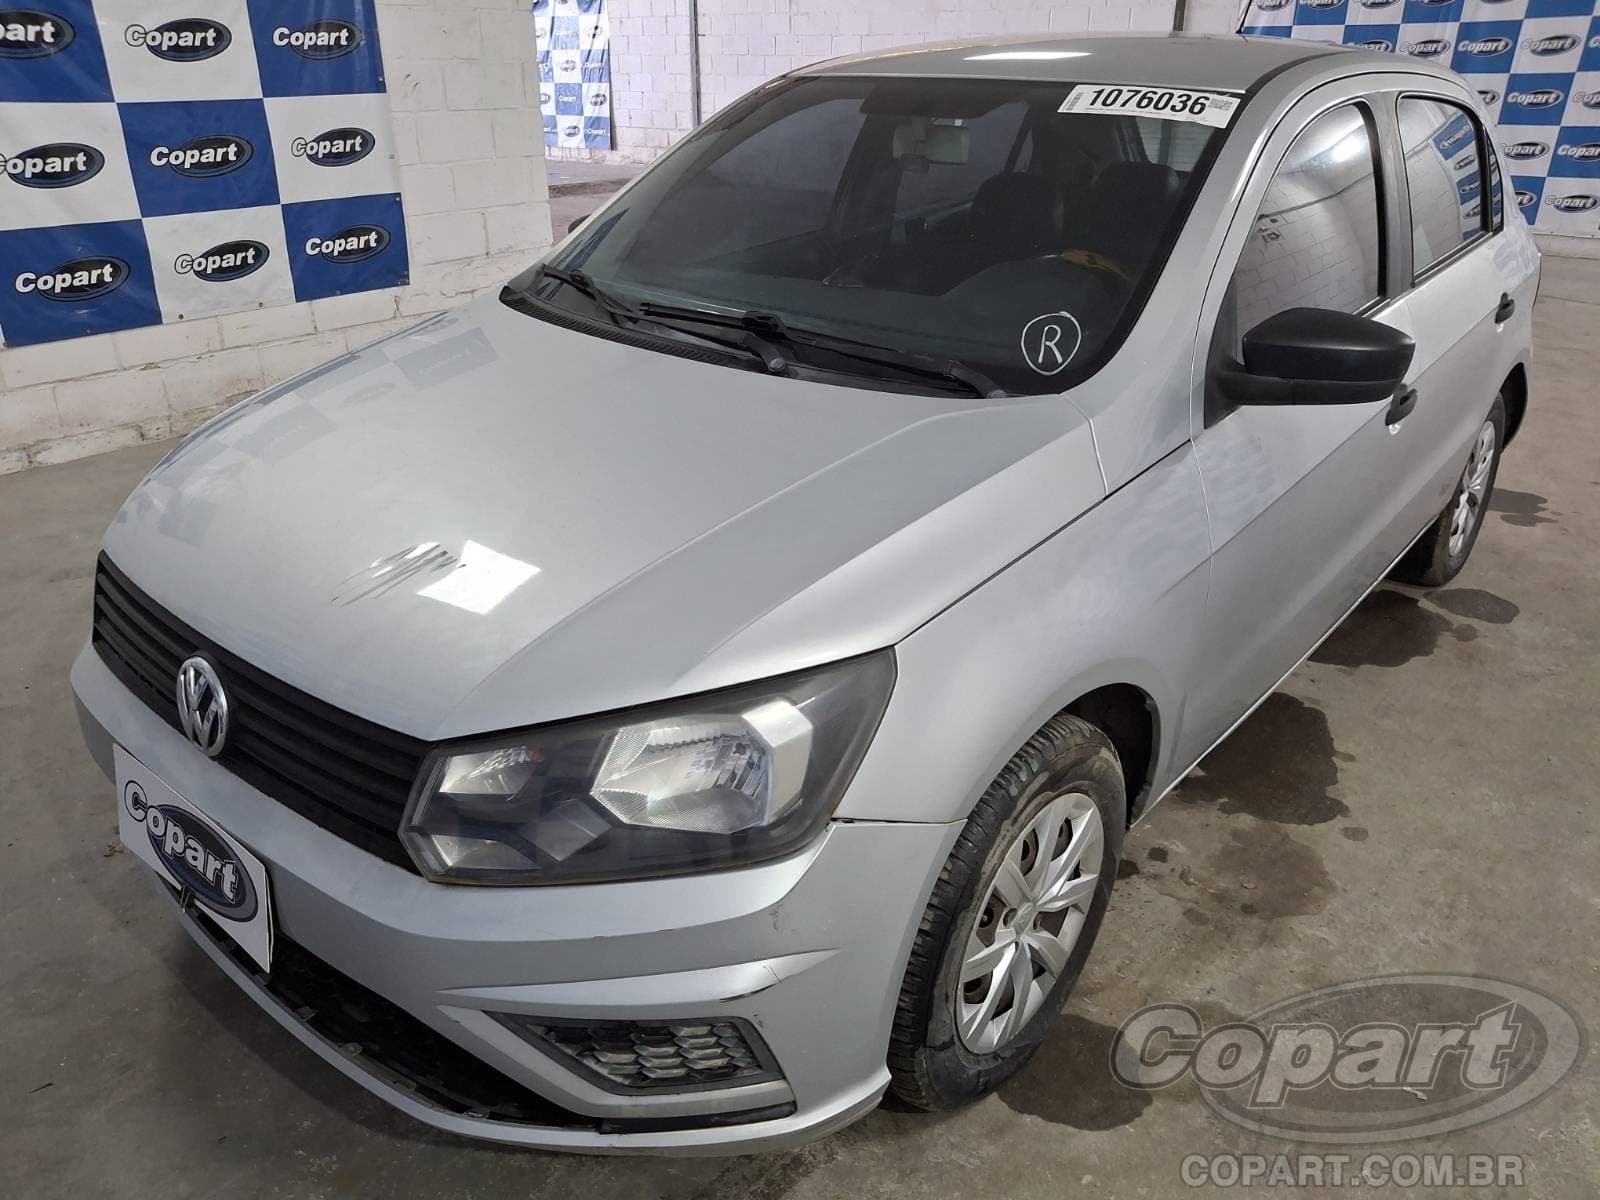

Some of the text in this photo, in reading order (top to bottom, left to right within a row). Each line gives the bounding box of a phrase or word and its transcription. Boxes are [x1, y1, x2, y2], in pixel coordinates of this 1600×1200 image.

[125, 24, 217, 51] Copart
[272, 26, 349, 49] Copart
[1400, 41, 1442, 54] Copart
[1458, 39, 1505, 54] Copart
[1521, 37, 1573, 53] Copart
[1089, 87, 1211, 115] 1076036
[1508, 91, 1559, 105] Copart
[150, 142, 238, 168] Copart
[291, 134, 363, 157] Copart
[1502, 143, 1542, 157] opart
[1545, 195, 1593, 208] Copart
[305, 228, 379, 256] Copart
[174, 247, 257, 274] Copart
[15, 262, 113, 293] Copart
[1038, 324, 1063, 364] R
[124, 780, 238, 904] Copart
